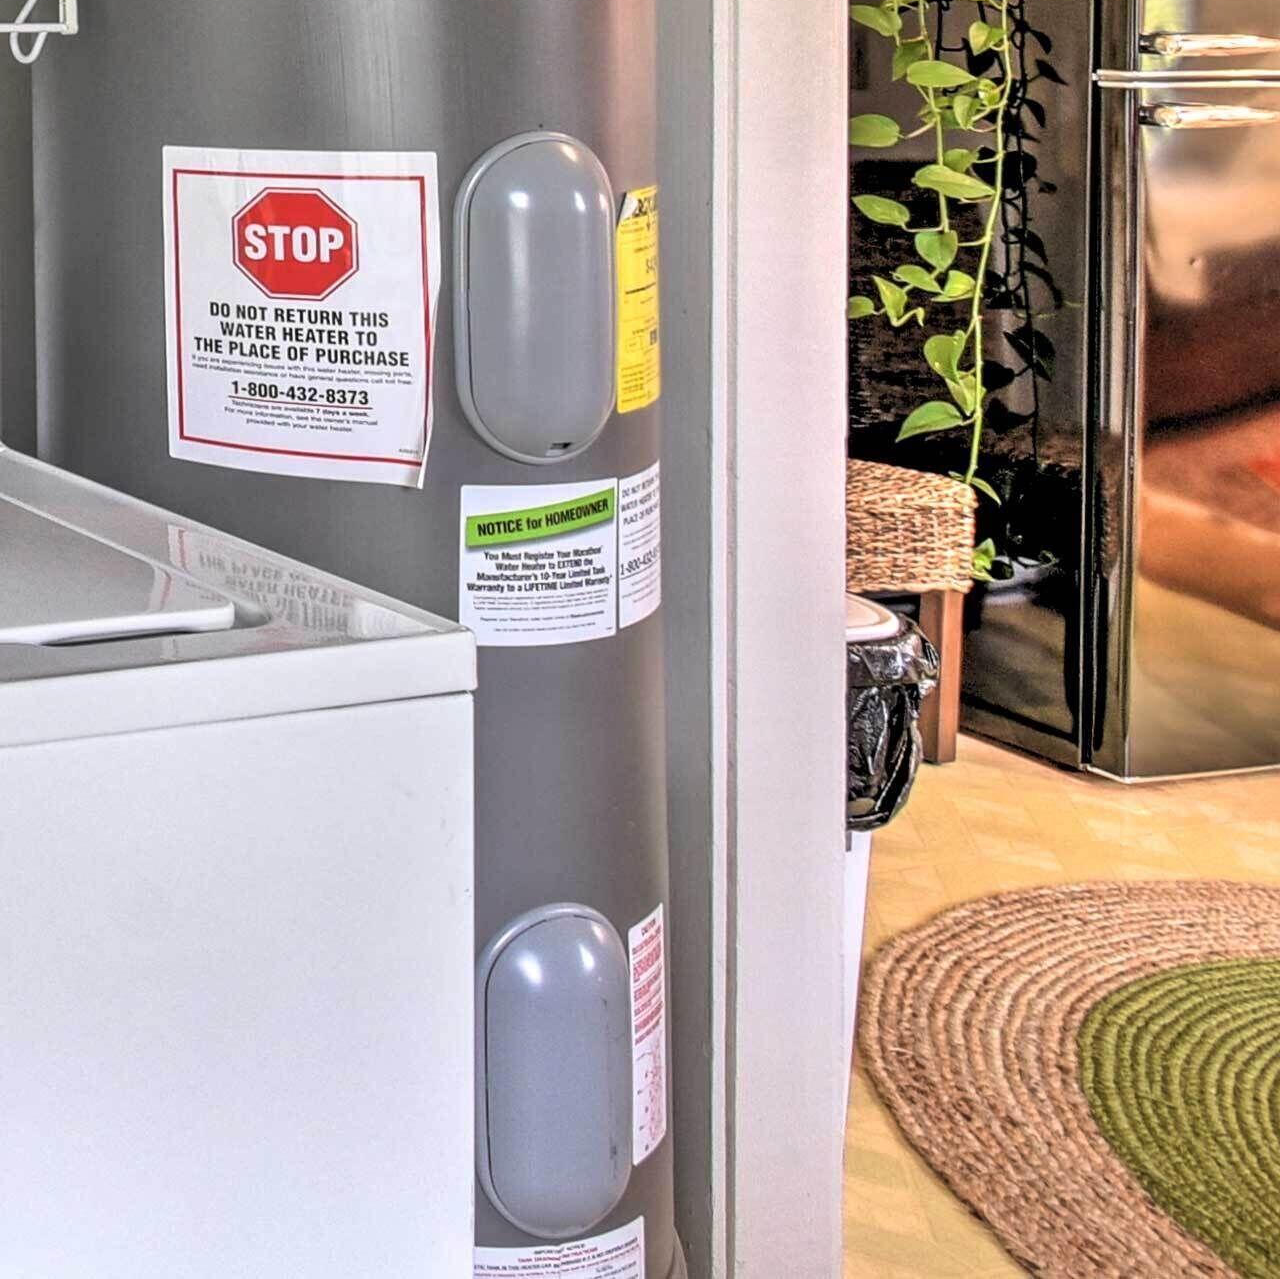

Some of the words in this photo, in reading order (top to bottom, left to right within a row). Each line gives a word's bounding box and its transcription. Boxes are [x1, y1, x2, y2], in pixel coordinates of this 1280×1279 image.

[244, 223, 344, 263] STOP
[210, 302, 231, 318] DO
[236, 305, 268, 321] NOT
[274, 307, 343, 326] RETURN
[349, 312, 389, 328] THIS
[220, 321, 276, 341] WATER
[283, 327, 349, 346] HEATER
[355, 331, 378, 347] TO
[194, 337, 223, 354] THE
[229, 341, 281, 360] PLACE
[287, 346, 309, 362] OF
[316, 348, 410, 367] PURCHASE
[232, 381, 369, 405] 1-800-432-8373
[477, 519, 523, 537] NOTICE
[526, 517, 542, 530] for
[545, 498, 609, 527] HOMEOWNER
[484, 552, 499, 561] You
[501, 551, 522, 560] Must
[523, 551, 555, 561] Register
[556, 550, 571, 558] Your
[495, 562, 519, 571] Water
[521, 561, 546, 571] Heater
[548, 562, 556, 570] to
[557, 559, 582, 569] EXTEND
[466, 583, 504, 594] Warranty
[507, 583, 515, 592] to
[524, 582, 557, 592] LIFETIME
[559, 580, 583, 590] Limited
[476, 572, 538, 581] Manufacturer's
[540, 572, 566, 580] 10-Year
